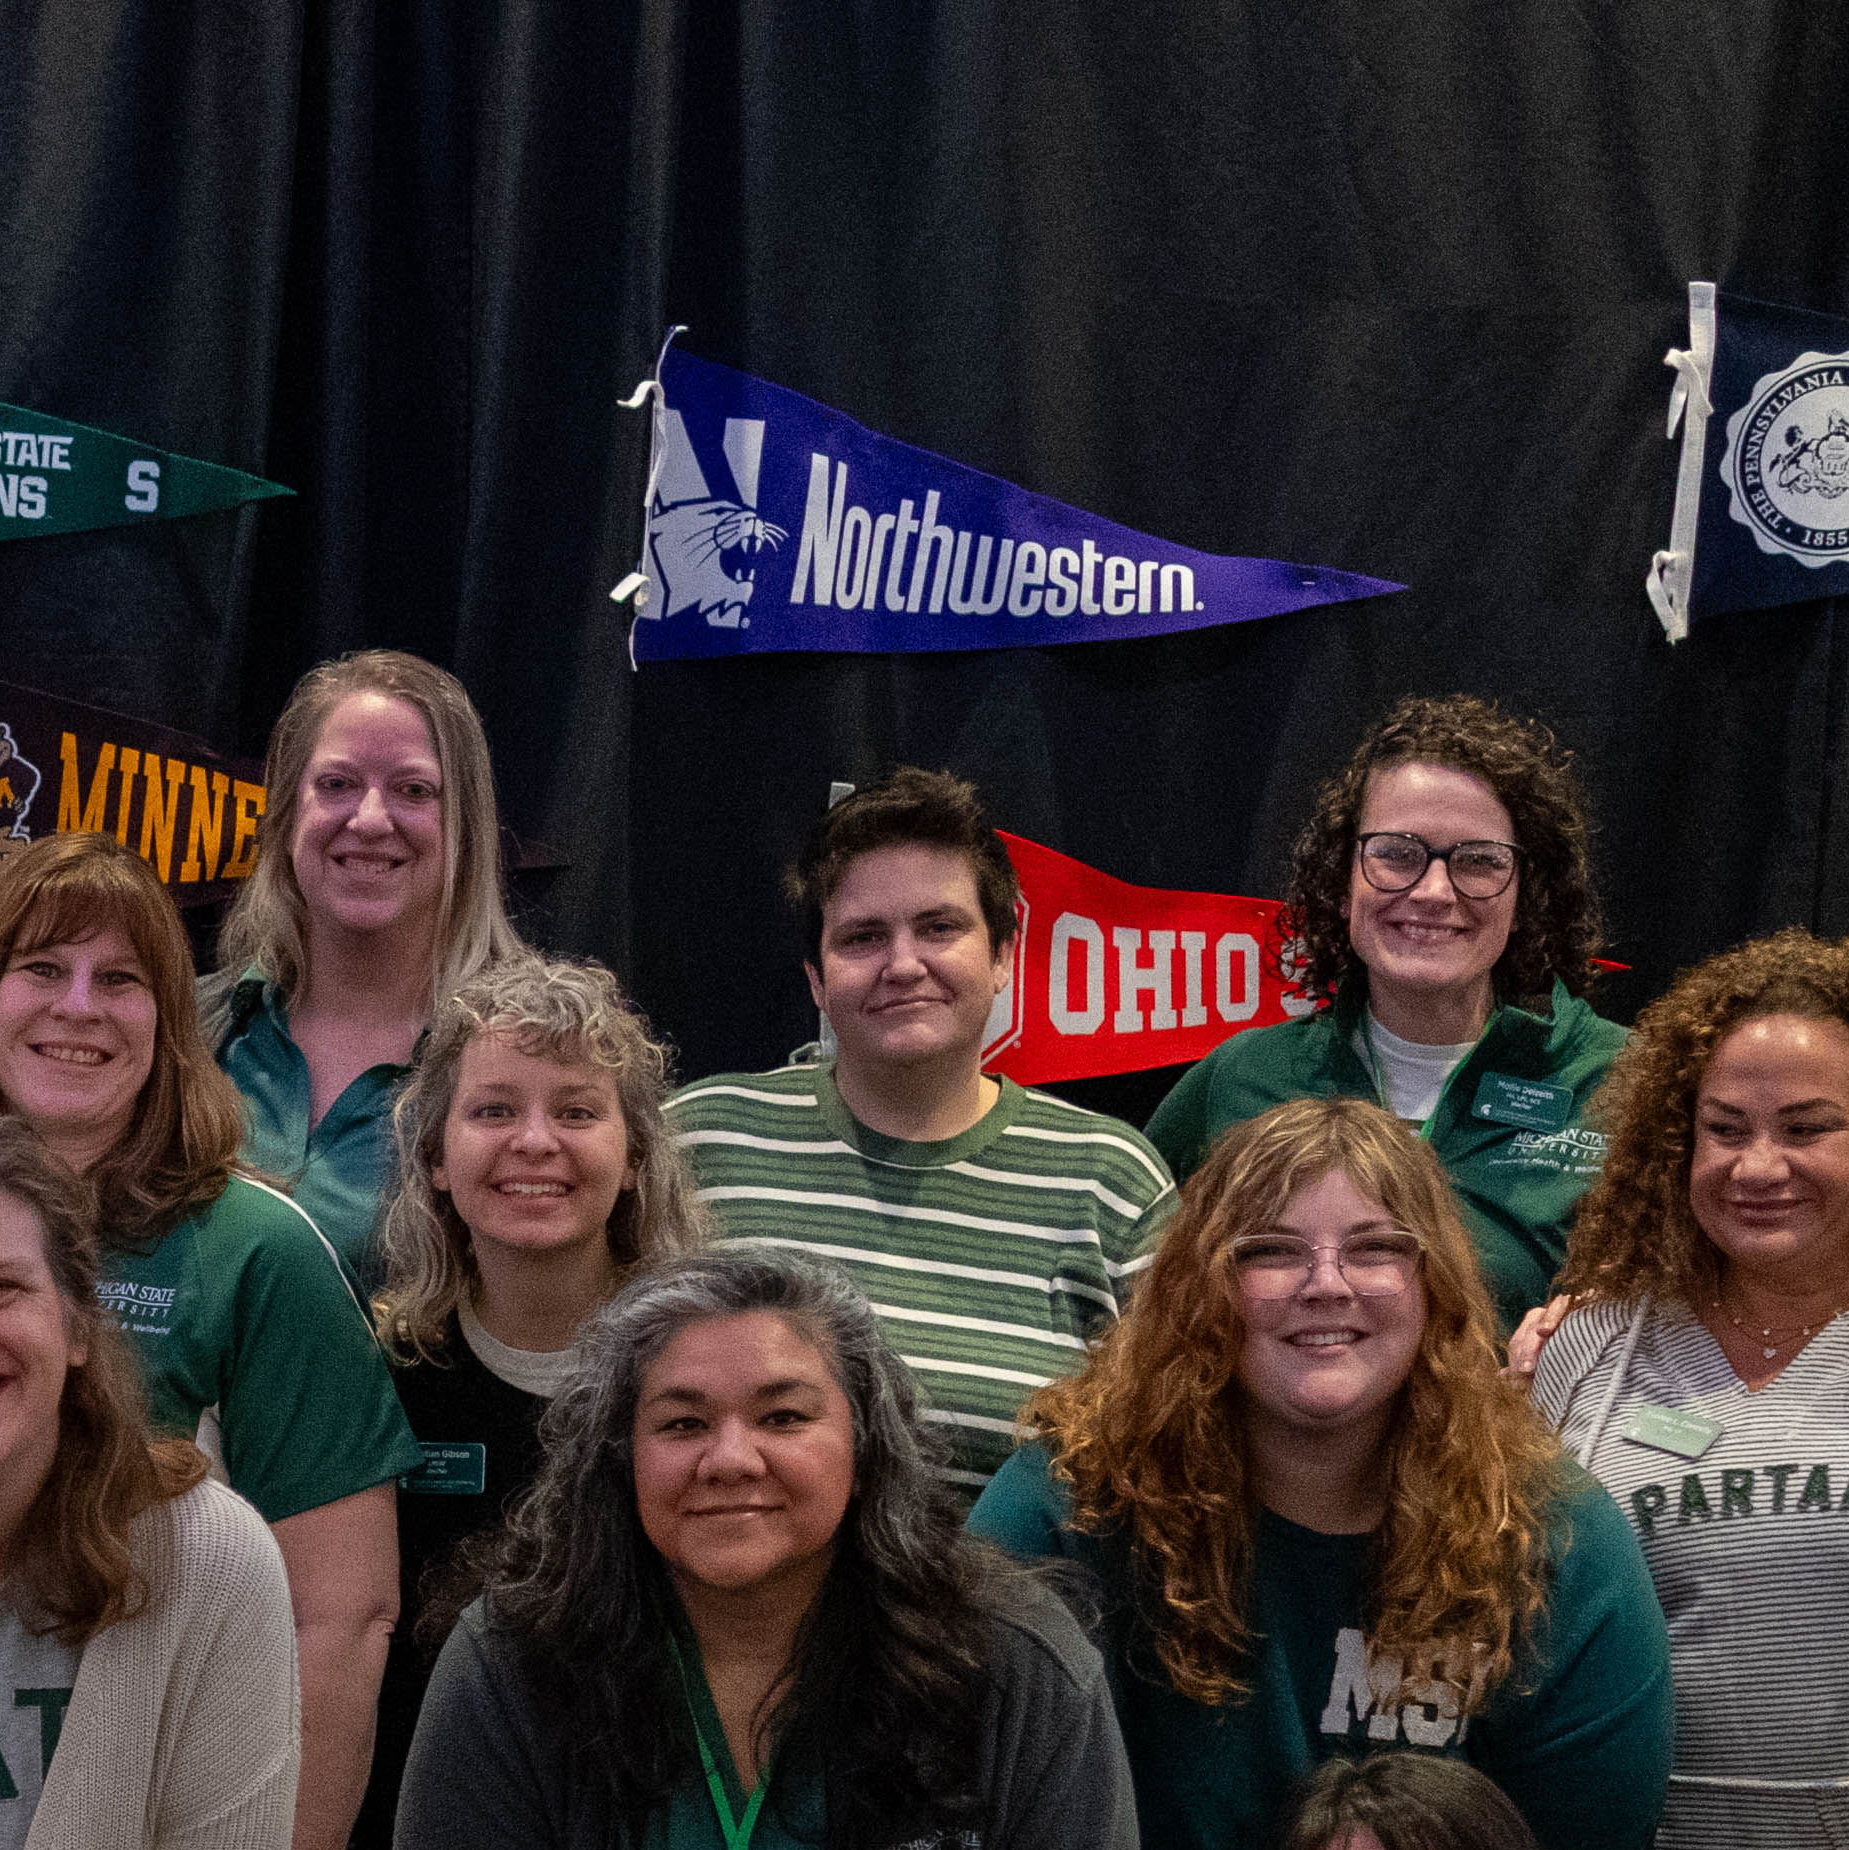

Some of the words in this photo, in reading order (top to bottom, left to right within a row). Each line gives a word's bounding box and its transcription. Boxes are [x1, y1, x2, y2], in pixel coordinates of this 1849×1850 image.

[1746, 370, 1843, 487] PENNSYLVANIA
[124, 459, 160, 512] S
[1751, 489, 1783, 529] THE
[1801, 529, 1848, 546] 1855
[57, 731, 267, 884] MINNE
[1049, 911, 1261, 1035] OHIO
[139, 1286, 176, 1302] STATE
